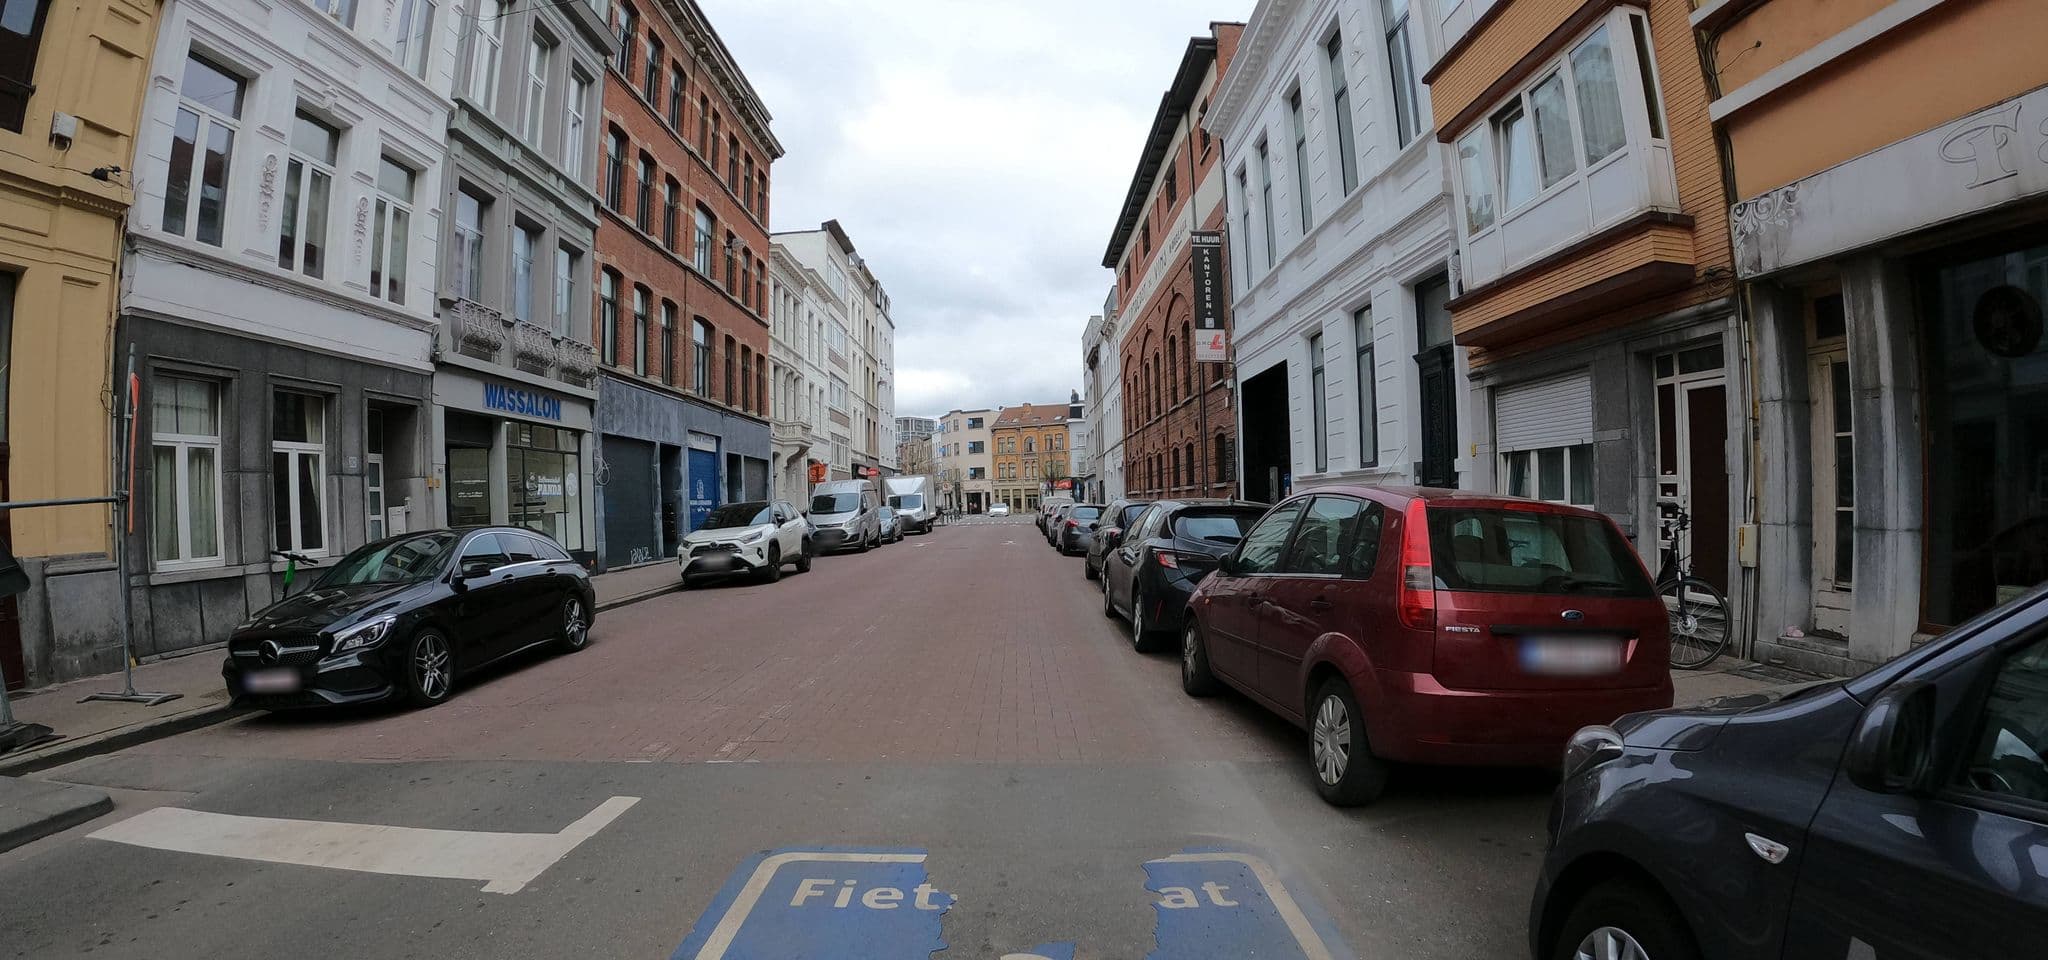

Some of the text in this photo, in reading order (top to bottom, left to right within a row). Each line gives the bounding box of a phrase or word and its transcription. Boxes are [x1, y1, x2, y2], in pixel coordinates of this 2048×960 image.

[1202, 235, 1220, 243] HUUR
[1203, 248, 1212, 309] KANTOREN
[485, 384, 561, 420] WASSALON
[537, 484, 561, 495] PANDA
[790, 877, 957, 911] Fiet
